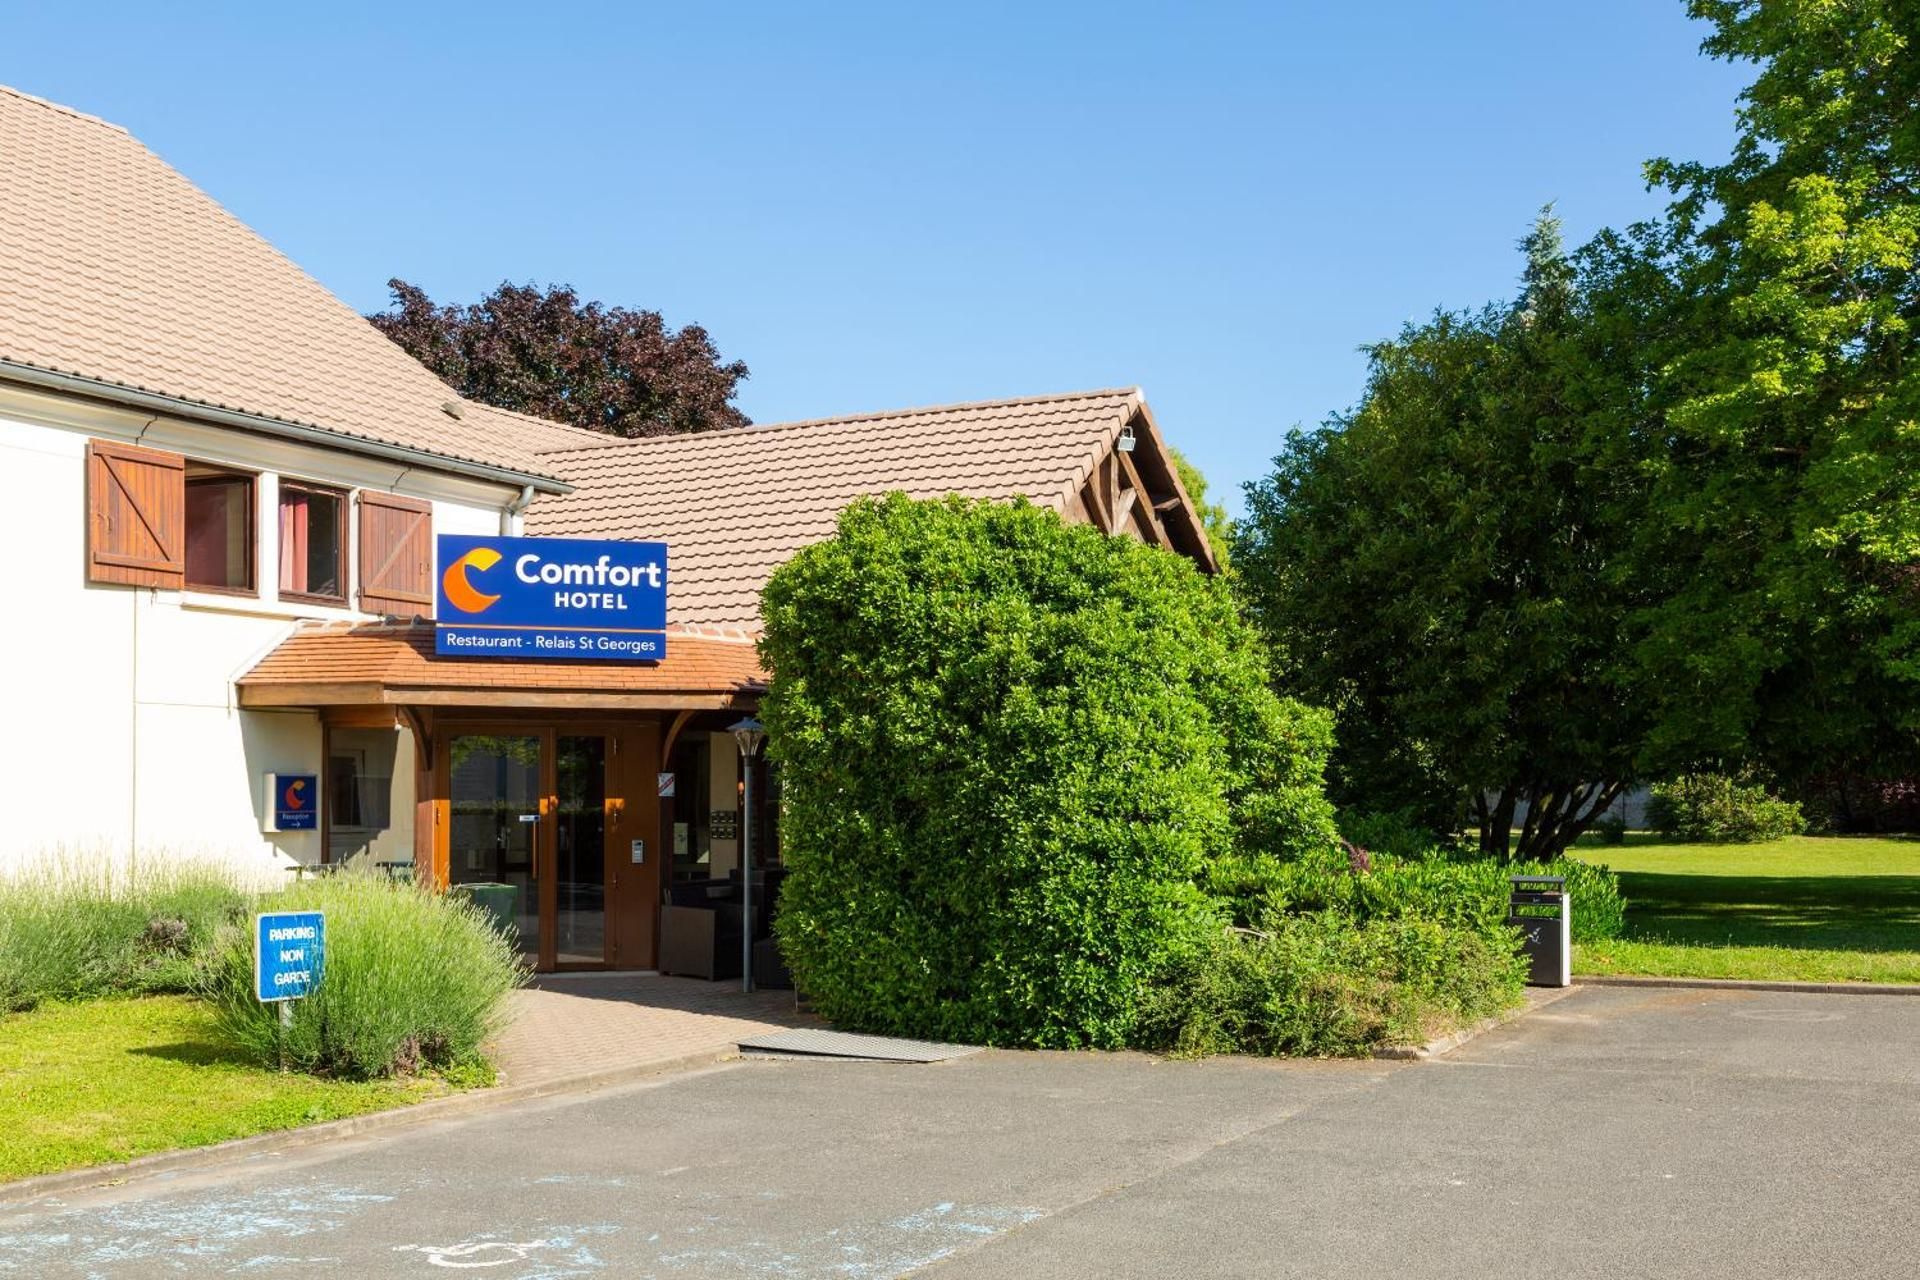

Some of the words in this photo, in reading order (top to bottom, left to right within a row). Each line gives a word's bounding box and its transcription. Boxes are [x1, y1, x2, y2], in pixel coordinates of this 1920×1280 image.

[515, 554, 661, 587] Comfort
[554, 592, 628, 609] HOTEL
[447, 633, 522, 648] Restaurant
[535, 637, 576, 649] Relais
[579, 638, 594, 650] St
[597, 638, 656, 653] Georges
[269, 927, 315, 941] PARKING
[280, 949, 304, 962] NON
